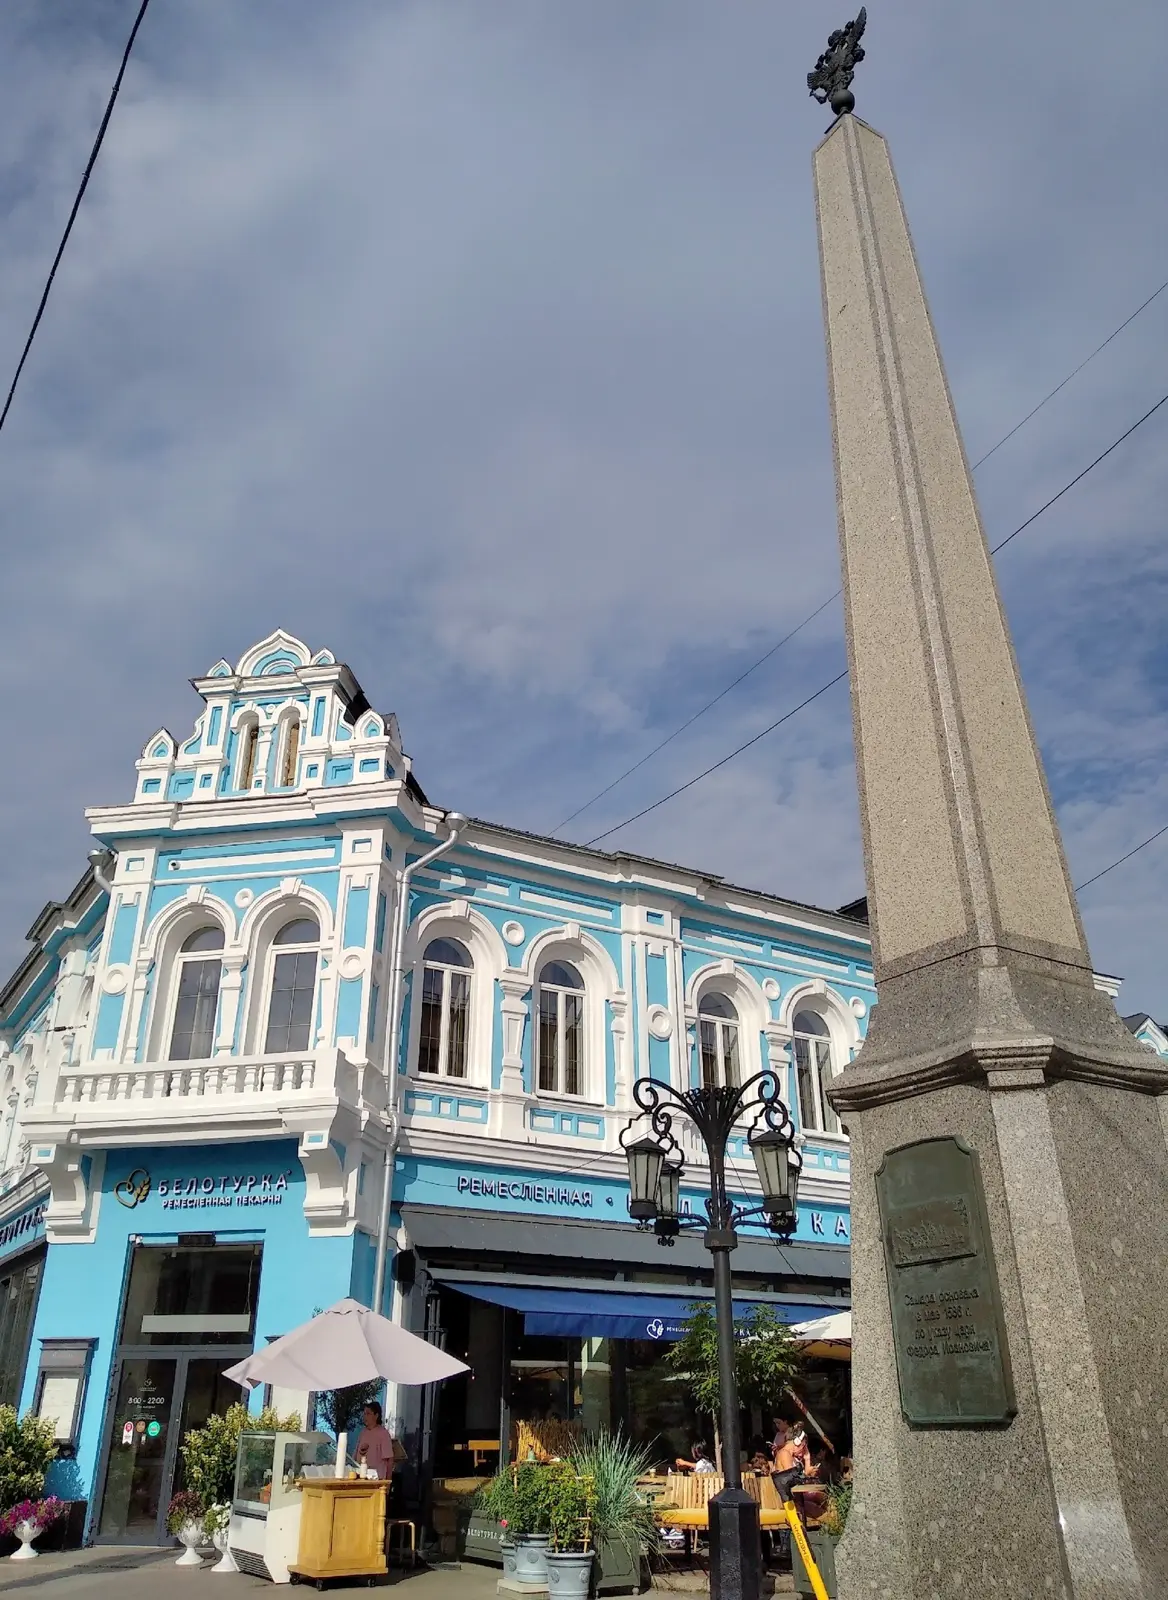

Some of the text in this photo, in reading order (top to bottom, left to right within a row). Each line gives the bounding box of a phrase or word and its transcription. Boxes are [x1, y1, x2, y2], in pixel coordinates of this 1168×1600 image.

[158, 1174, 288, 1196] БЕЛОТУРКА
[458, 1175, 593, 1207] РЕМЕСЛЕННАЯ
[162, 1194, 282, 1210] РЕМЕСЛЕННАЯ ПЕКАРНЯ
